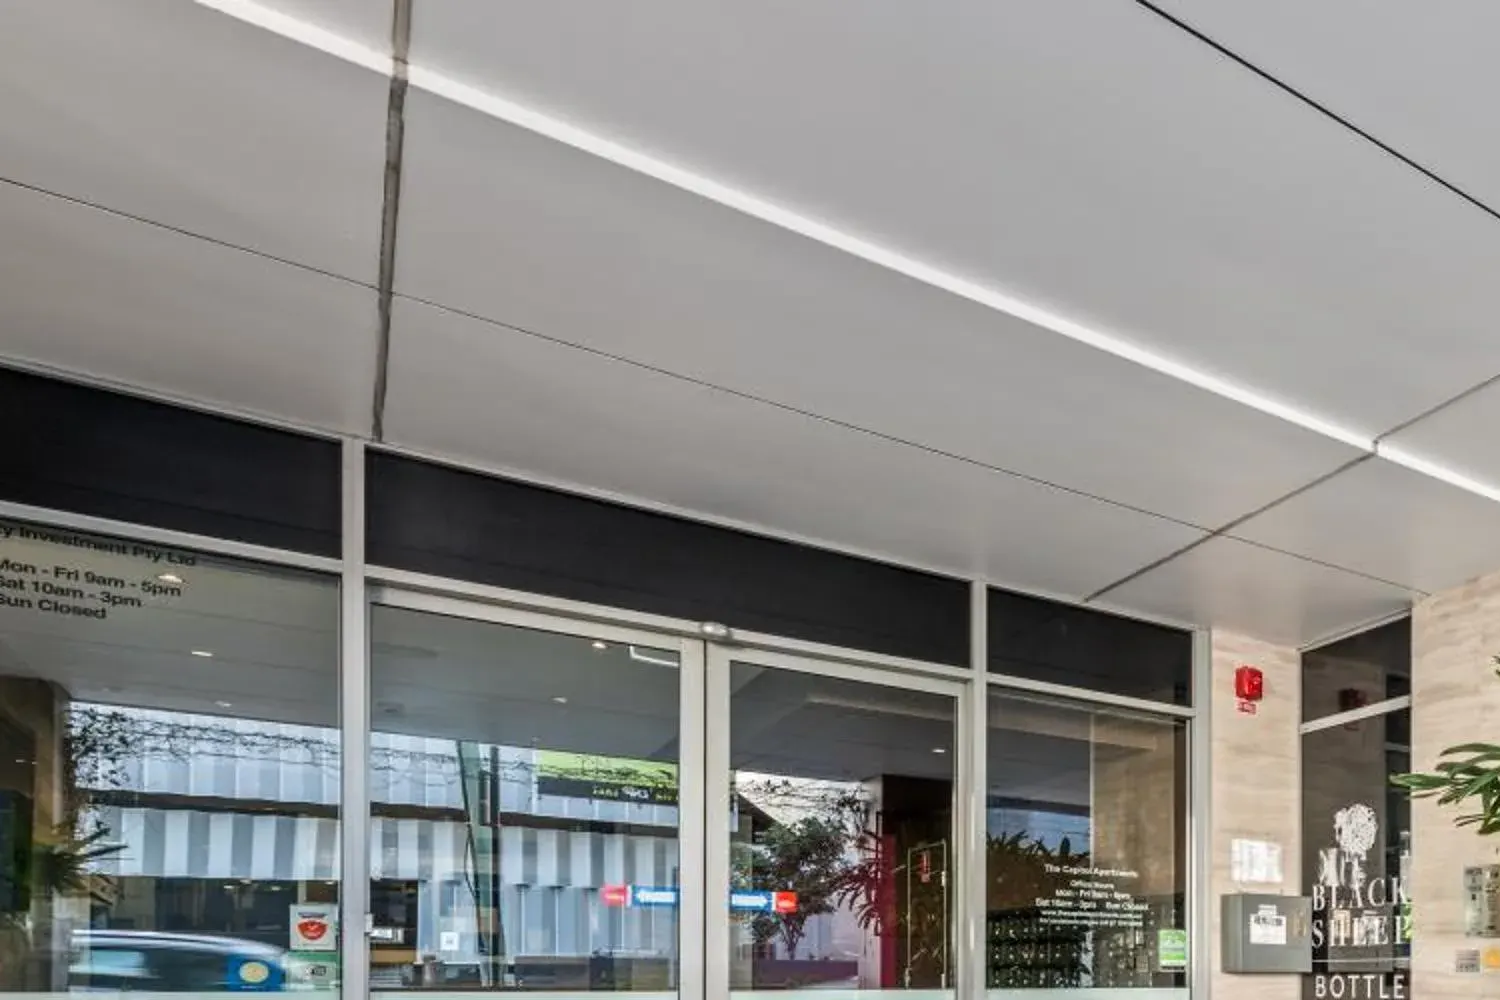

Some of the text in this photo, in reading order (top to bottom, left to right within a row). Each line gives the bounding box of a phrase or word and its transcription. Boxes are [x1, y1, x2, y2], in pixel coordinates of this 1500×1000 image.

[20, 526, 127, 555] Investment
[132, 545, 161, 563] Pty
[168, 551, 197, 566] Ltd
[31, 580, 83, 599] 10am
[99, 591, 141, 608] 3pm
[54, 565, 79, 581] Fri
[84, 571, 125, 588] 9am
[141, 580, 181, 597] 5pm
[38, 599, 107, 619] Closed
[1312, 876, 1408, 911] BLACK
[1314, 974, 1405, 999] BOTTLE
